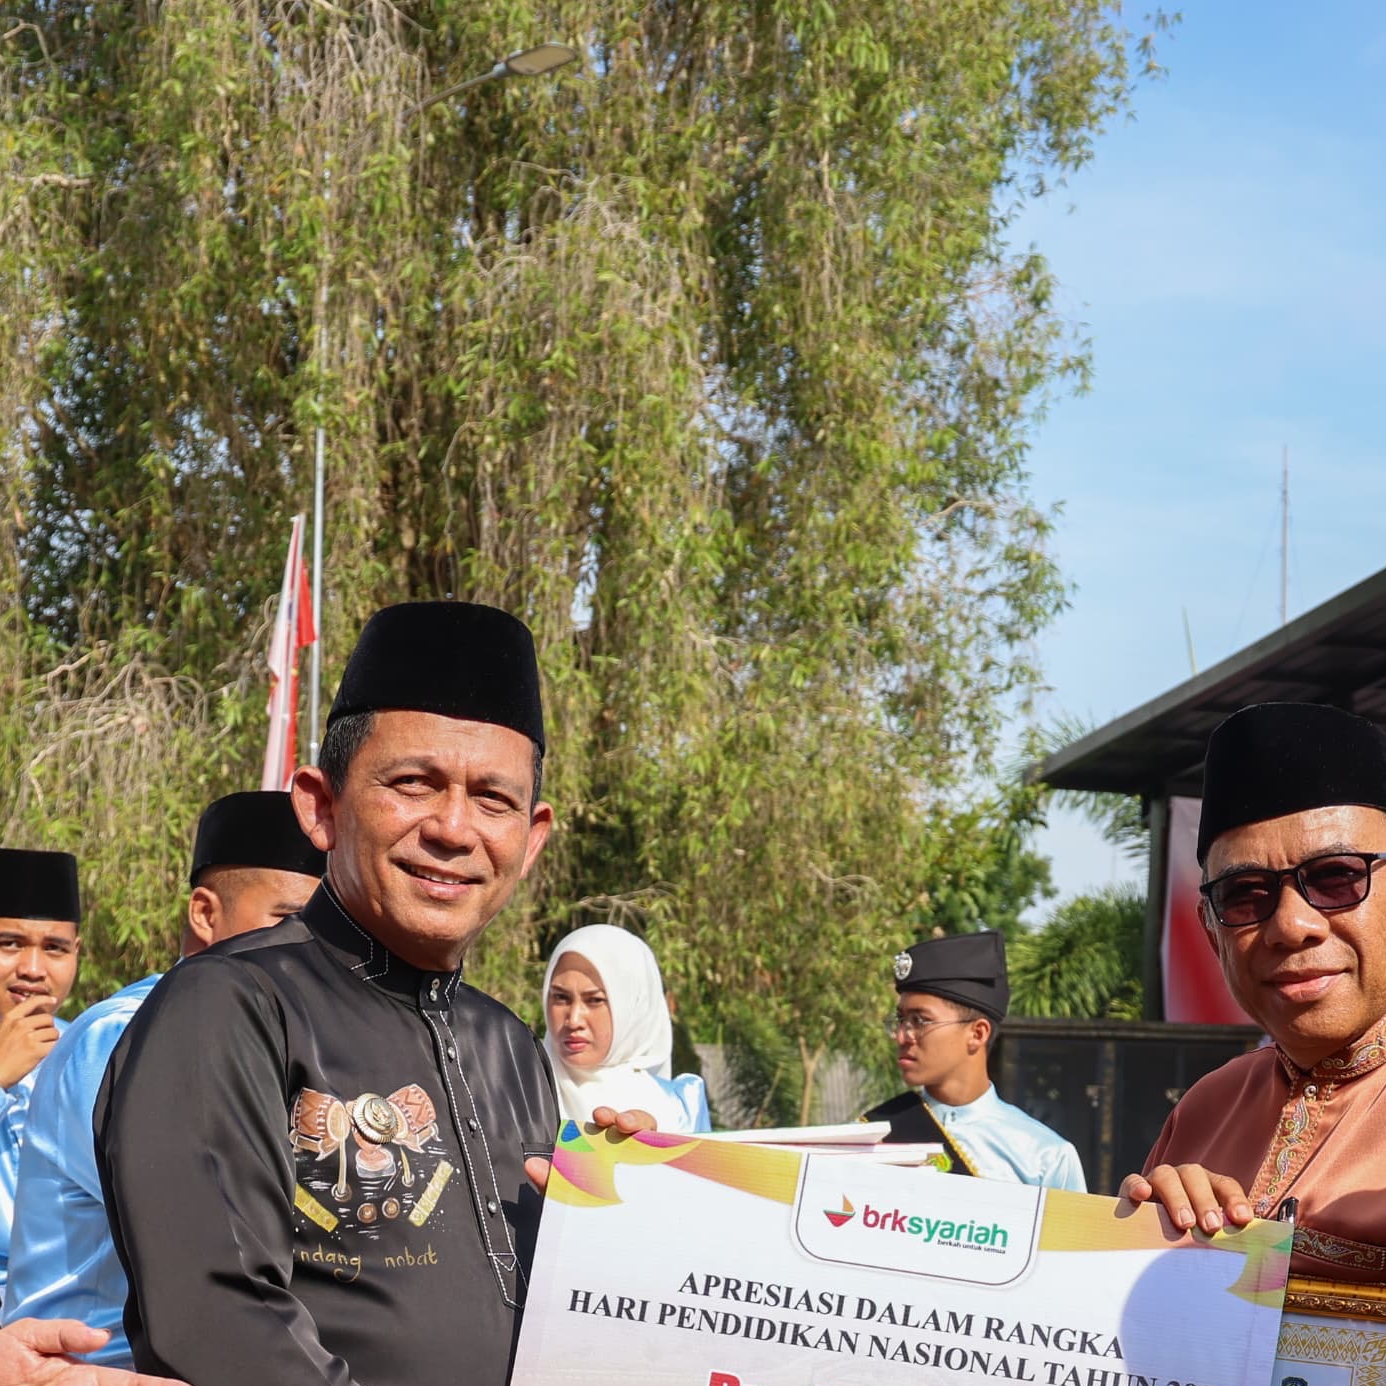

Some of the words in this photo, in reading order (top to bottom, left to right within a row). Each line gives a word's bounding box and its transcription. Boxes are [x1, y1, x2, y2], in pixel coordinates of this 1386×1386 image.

[863, 1205, 1008, 1247] brksyariah
[937, 1239, 961, 1248] berkah
[962, 1243, 982, 1251] untuk
[983, 1246, 1006, 1255] semua
[293, 1243, 362, 1283] ndang
[568, 1288, 651, 1323] HARI
[656, 1302, 860, 1355] PENDIDIKAN
[868, 1334, 1036, 1382] NASIONAL
[678, 1271, 848, 1318] APRESIASI
[855, 1296, 975, 1337] DALAM
[984, 1316, 1125, 1360] RANGKA
